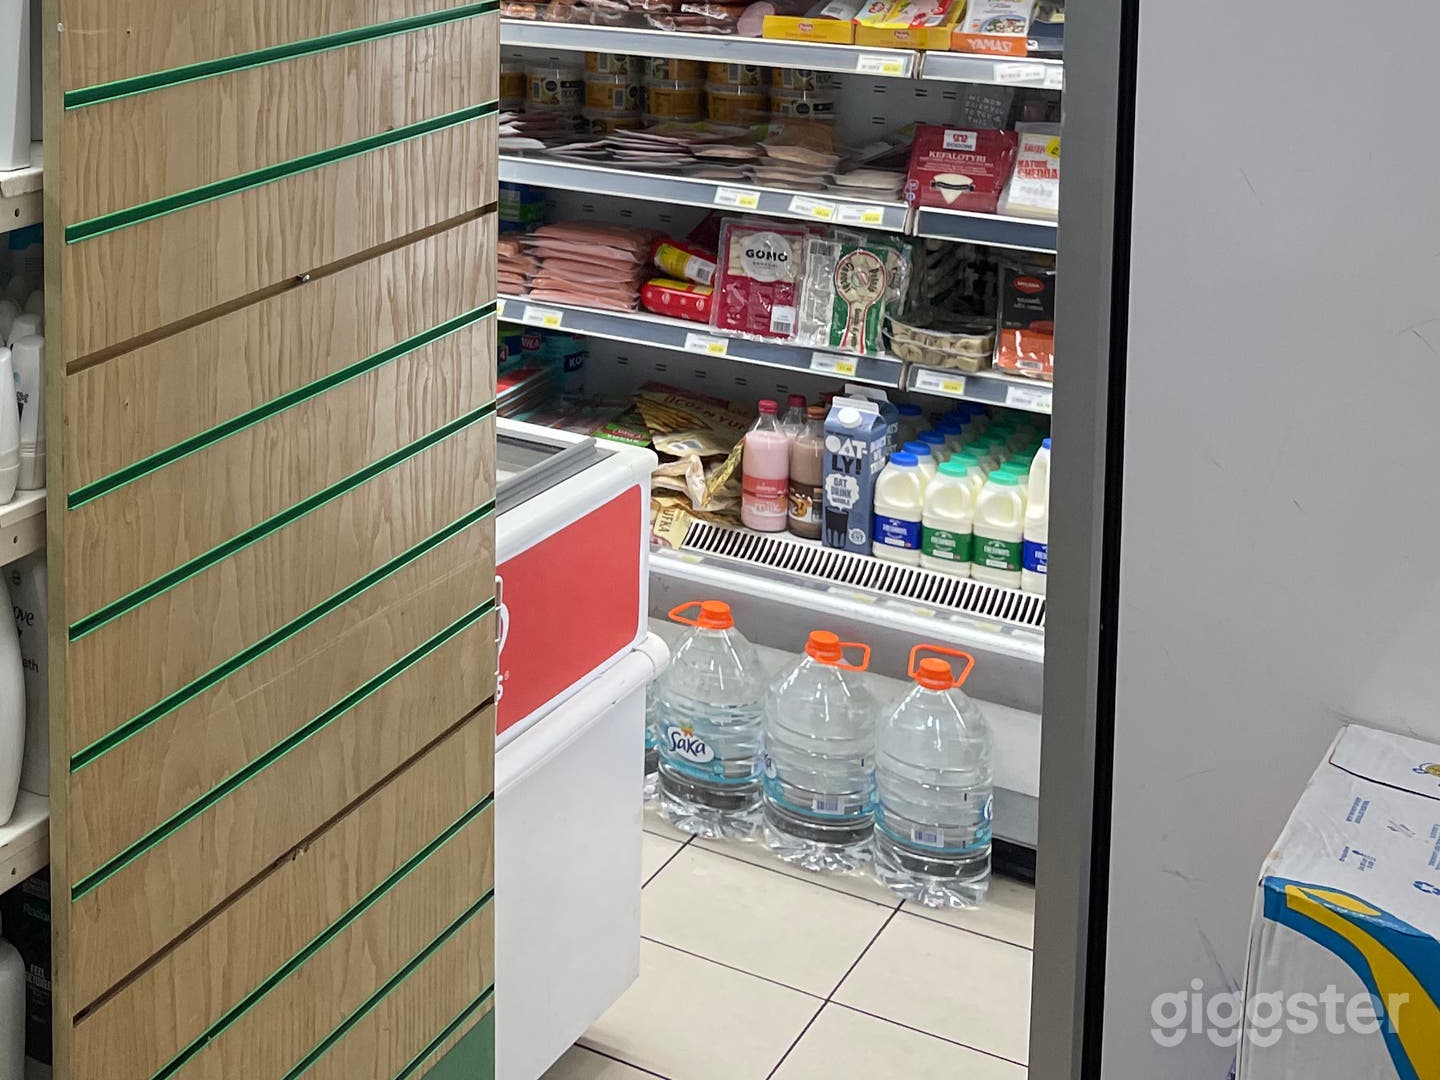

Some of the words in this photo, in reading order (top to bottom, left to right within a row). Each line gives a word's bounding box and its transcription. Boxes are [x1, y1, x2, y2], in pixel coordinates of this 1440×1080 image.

[968, 39, 1012, 52] YAMAS
[928, 151, 986, 163] KEFALOTYRI
[745, 249, 788, 262] GOMO
[833, 477, 848, 487] OAT
[831, 487, 852, 499] DRINK
[668, 731, 707, 758] Saka
